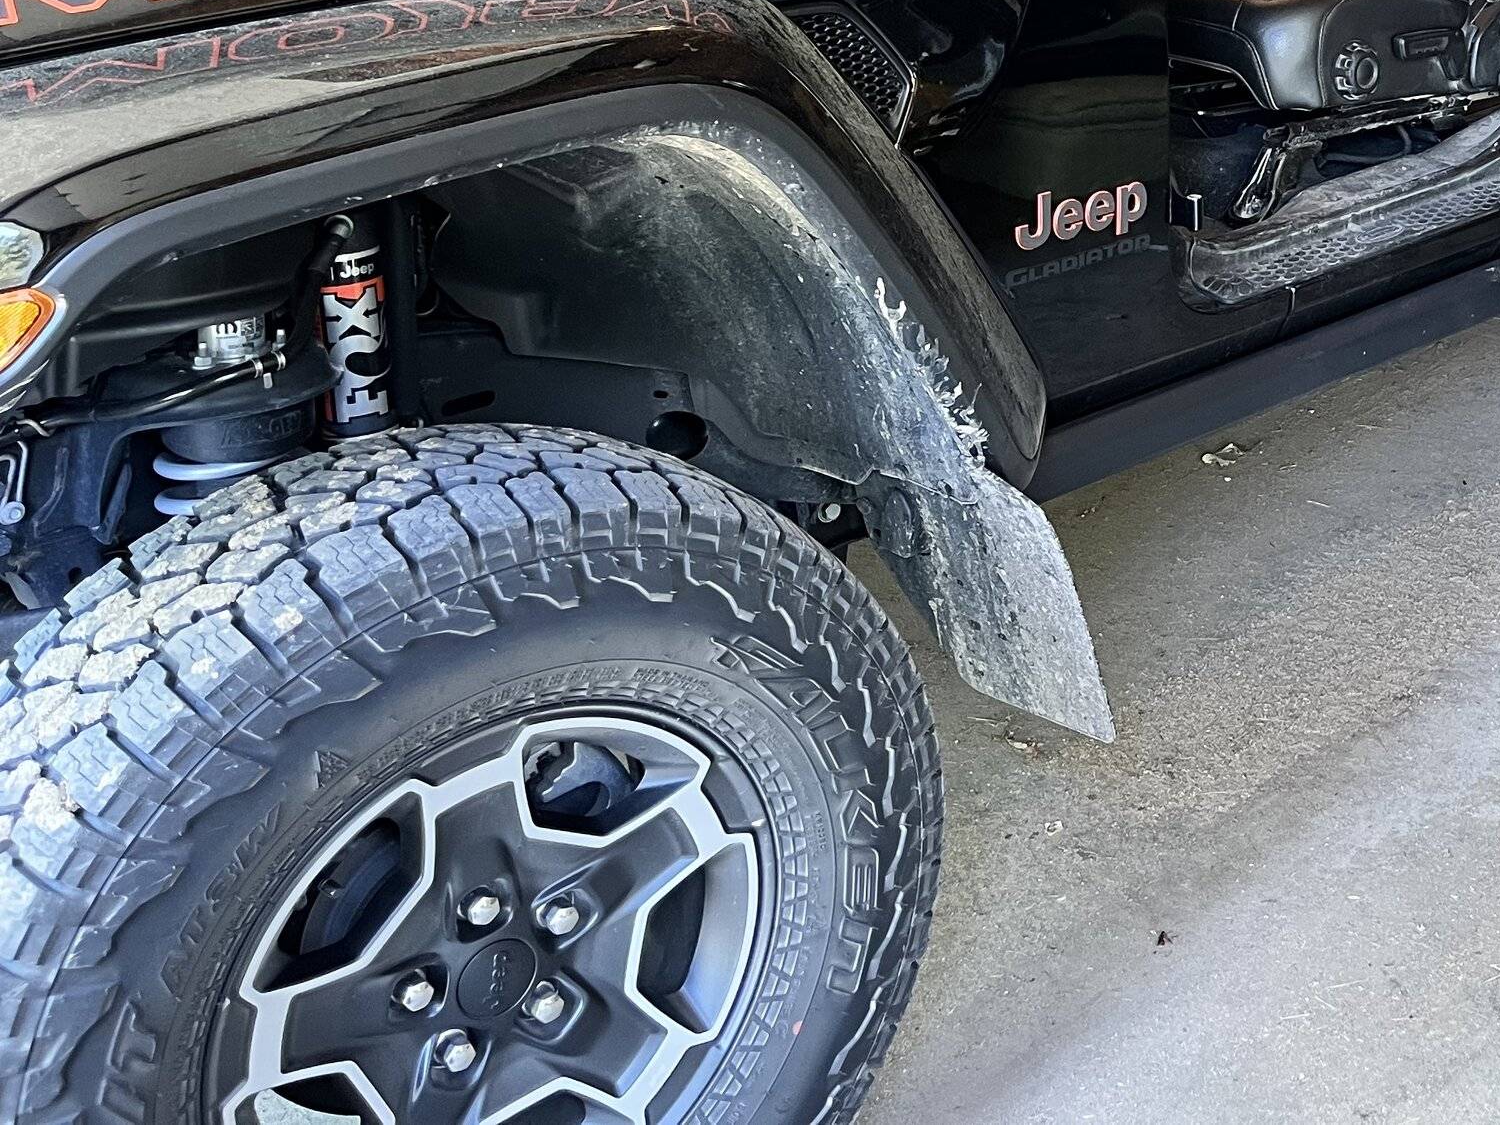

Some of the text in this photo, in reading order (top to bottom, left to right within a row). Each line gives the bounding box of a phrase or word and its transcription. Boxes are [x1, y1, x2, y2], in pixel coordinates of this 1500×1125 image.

[1014, 180, 1149, 251] Jeep
[339, 260, 375, 280] Jeep
[1004, 232, 1151, 289] GLADIATOR
[322, 285, 391, 423] FOX
